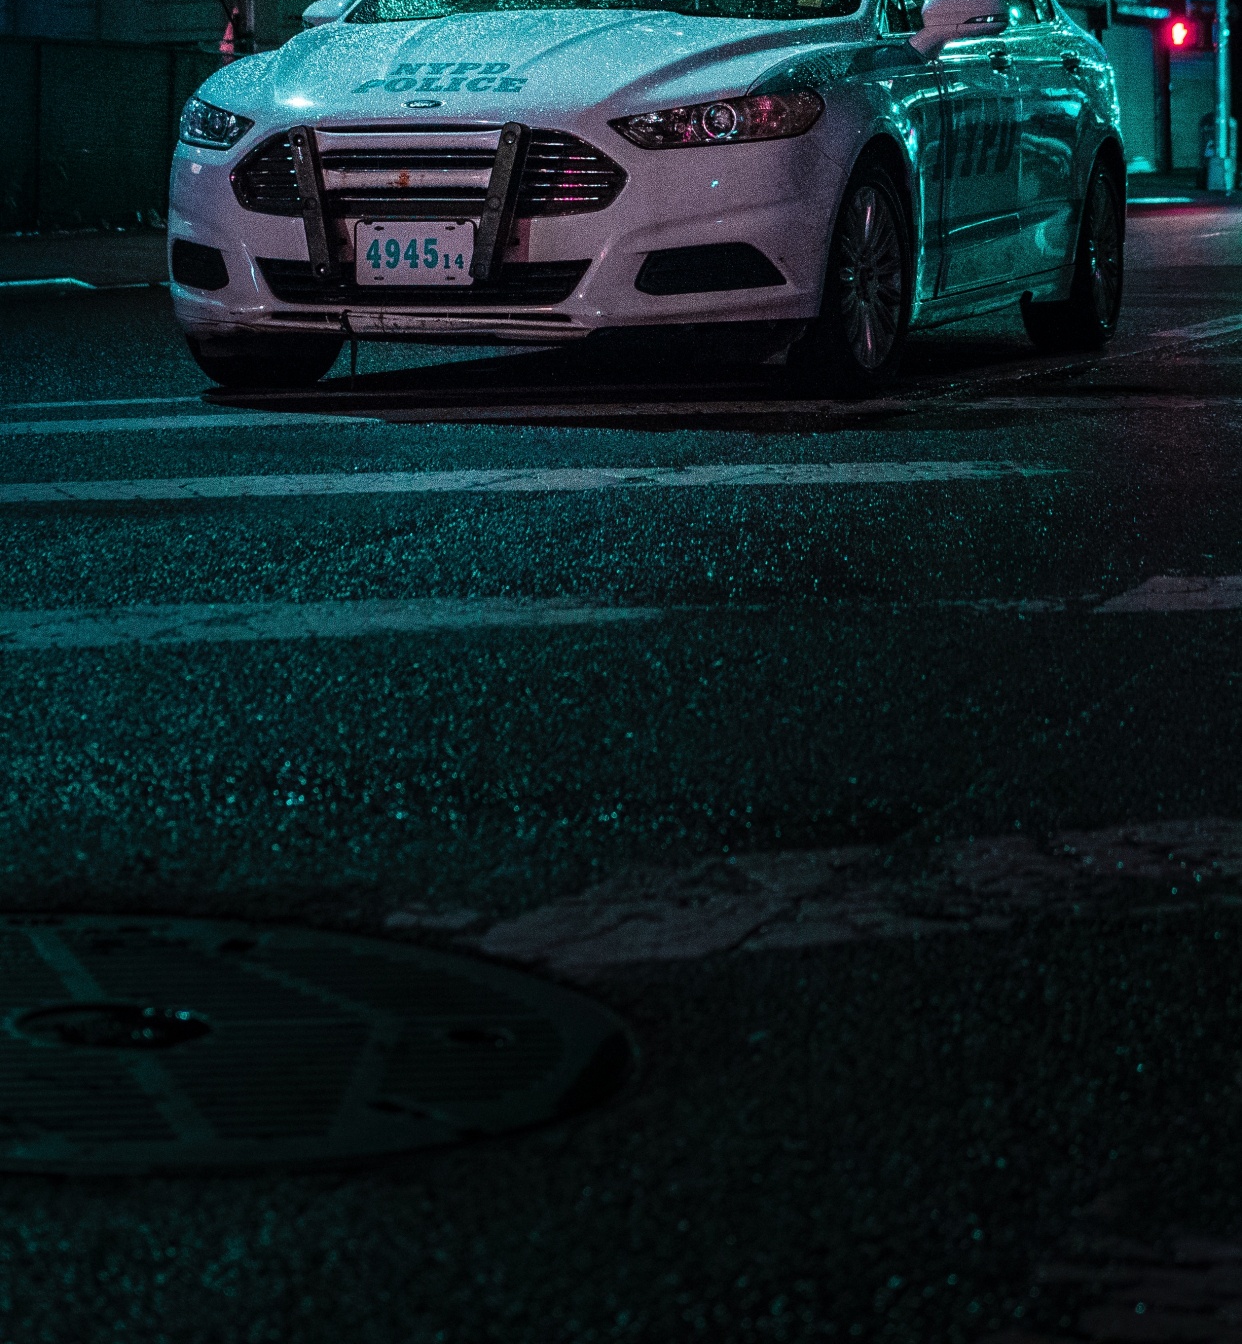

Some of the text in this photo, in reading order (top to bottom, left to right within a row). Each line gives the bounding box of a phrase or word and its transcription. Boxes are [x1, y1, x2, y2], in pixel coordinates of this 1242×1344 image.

[389, 62, 511, 76] NYPD
[351, 77, 529, 94] POLICE
[366, 238, 465, 269] 4945 14
